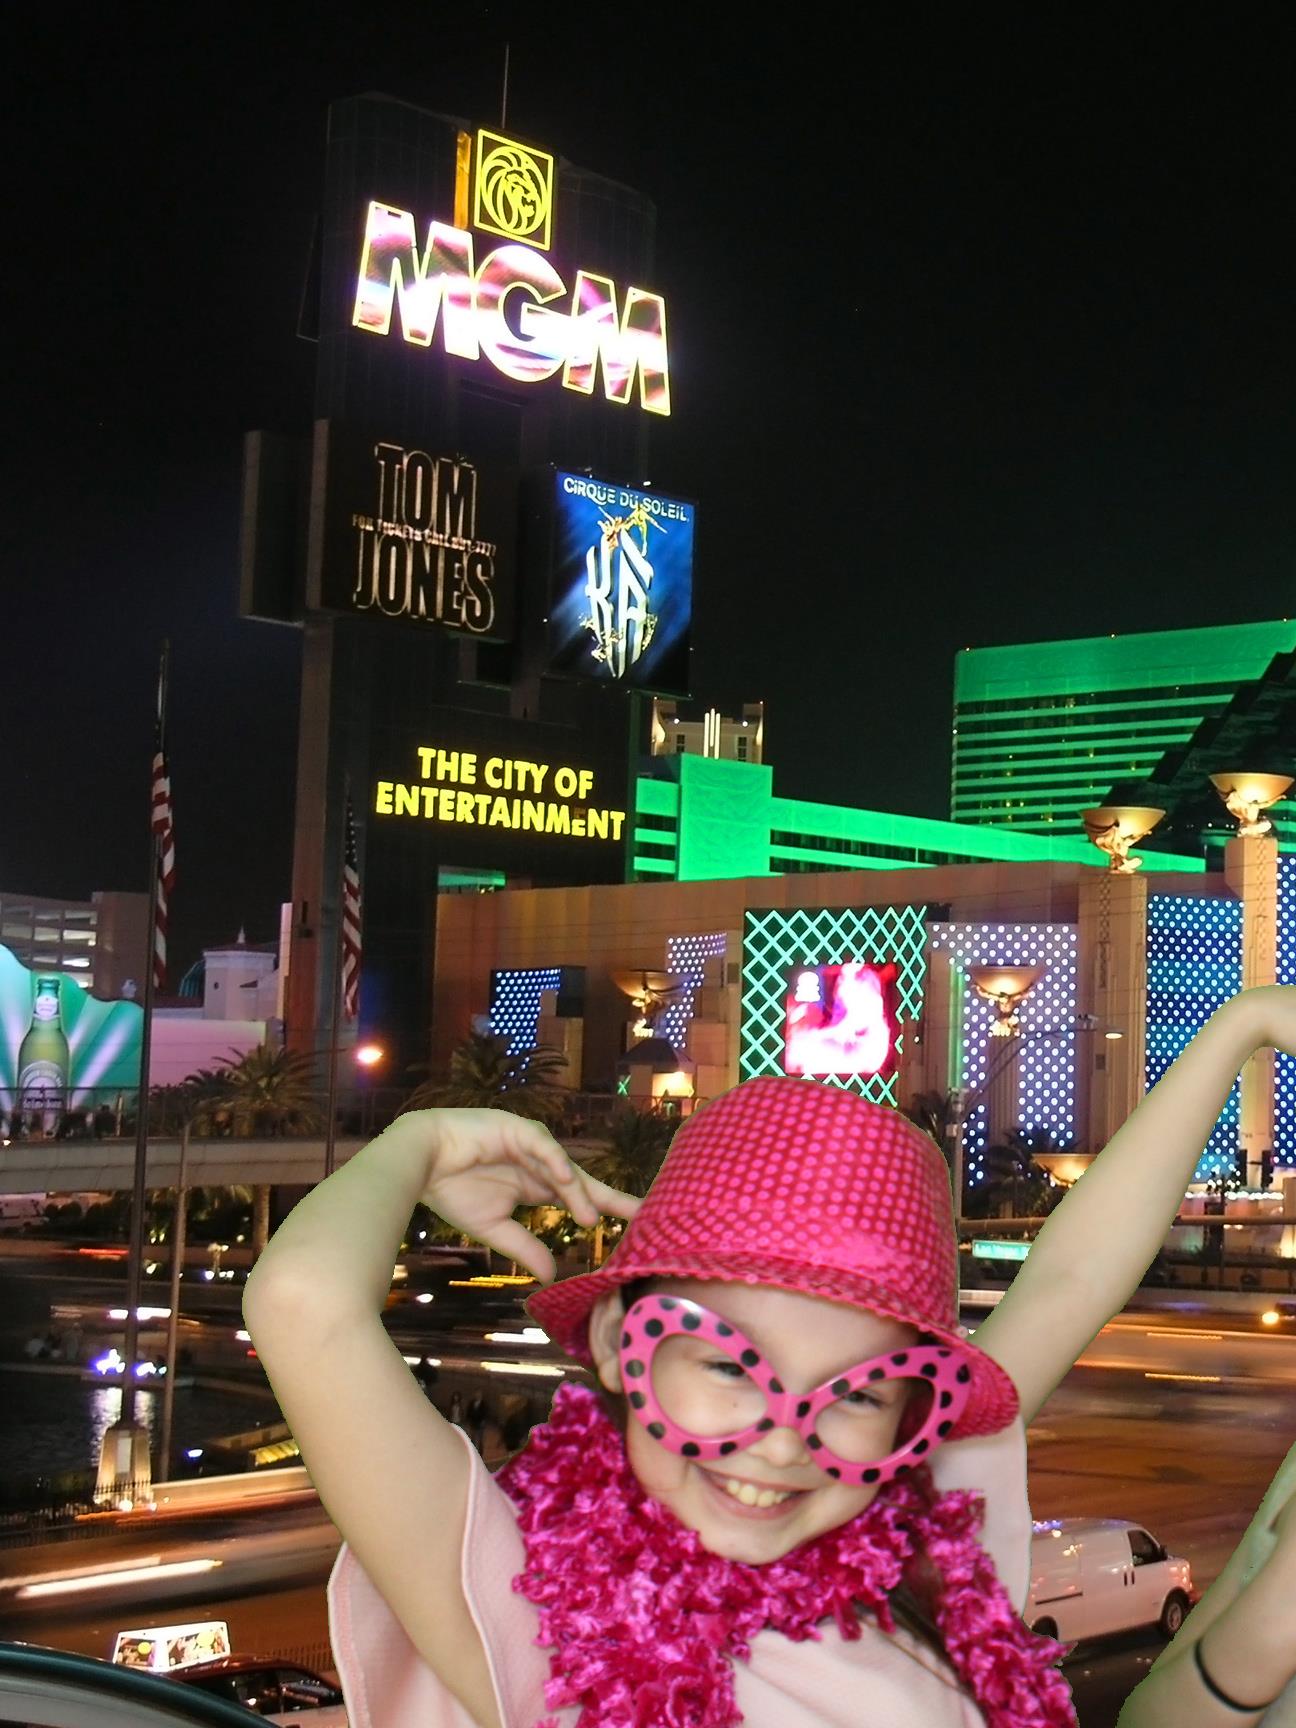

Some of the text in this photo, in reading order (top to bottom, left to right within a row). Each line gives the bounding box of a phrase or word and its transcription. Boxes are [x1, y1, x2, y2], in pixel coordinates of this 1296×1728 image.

[352, 200, 671, 416] MGM
[374, 442, 478, 540] TOM
[353, 530, 495, 633] JONES
[375, 781, 626, 840] ENTERTAINMENT
[418, 746, 594, 799] THE CITY OF
